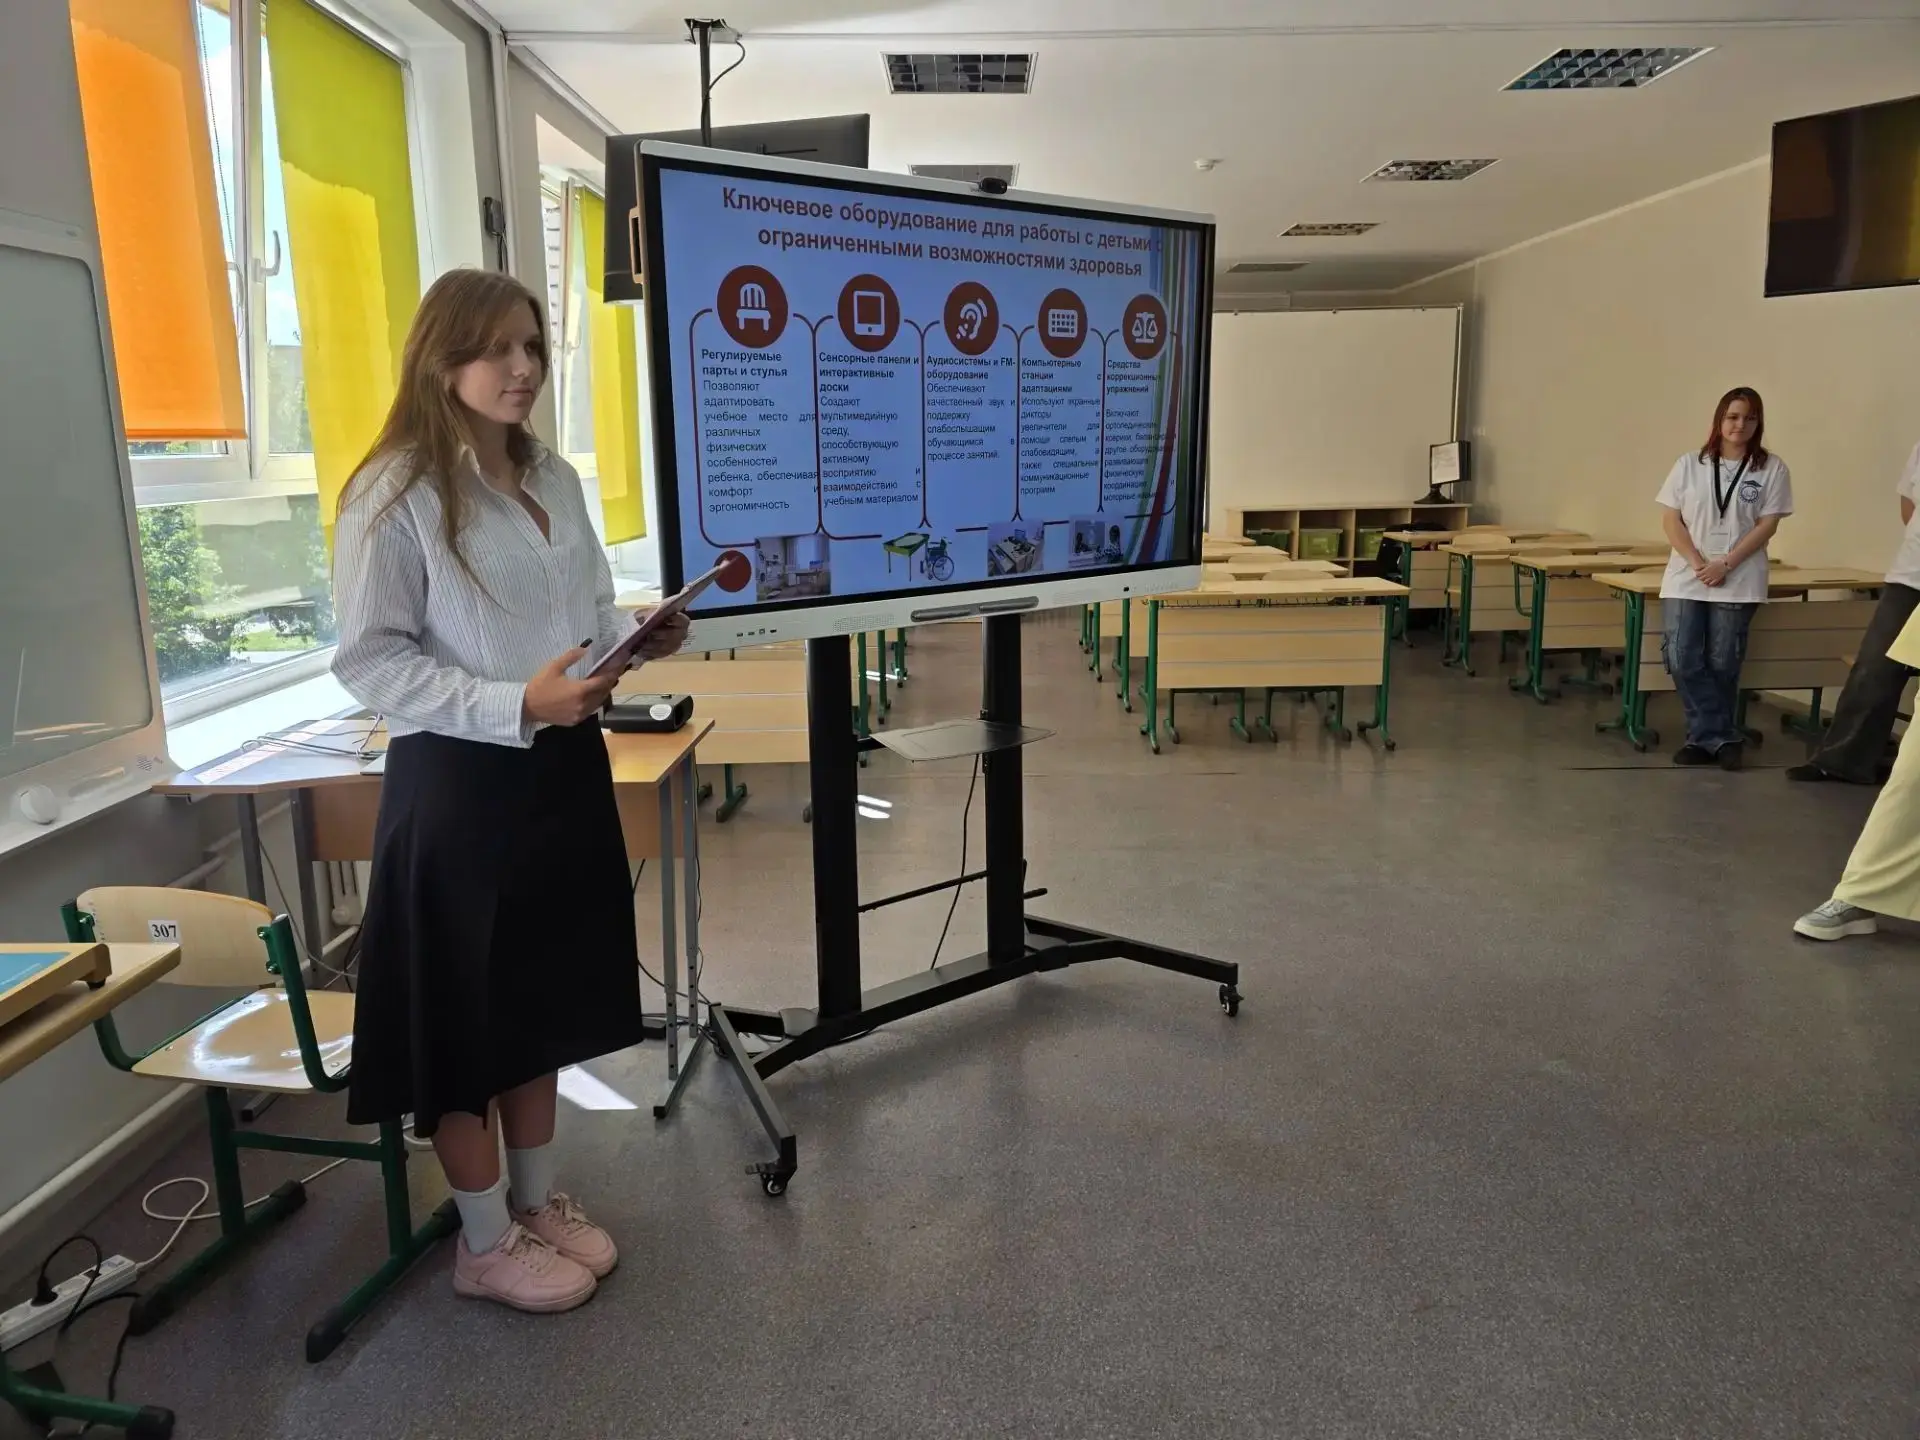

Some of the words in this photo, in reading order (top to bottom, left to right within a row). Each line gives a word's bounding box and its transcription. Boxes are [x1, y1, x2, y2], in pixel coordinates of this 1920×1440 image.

[723, 187, 833, 219] Ключевое
[839, 203, 978, 233] оборудование
[982, 220, 1015, 238] для
[1020, 226, 1080, 245] работы
[1085, 232, 1093, 246] с
[1097, 233, 1151, 251] детьми
[758, 228, 923, 259] ограниченными
[929, 245, 1065, 270] возможностями
[1069, 259, 1142, 277] здоровья
[701, 349, 782, 363] Регулируемые
[819, 352, 875, 365] Сенсорные
[878, 355, 911, 365] панели
[914, 357, 919, 365] и
[926, 355, 991, 367] Аудиосистемы
[1000, 357, 1016, 366] FM-
[1021, 358, 1082, 368] Компьютерные
[1107, 359, 1141, 370] Средства
[702, 366, 737, 377] парты
[740, 367, 747, 376] и
[750, 367, 788, 378] стулья
[819, 368, 894, 379] интерактивные
[926, 369, 989, 381] оборудование
[1021, 372, 1054, 382] станции
[703, 380, 760, 391] Позволяют
[820, 384, 849, 393] доски
[926, 382, 986, 393] Обеспечивают
[1021, 385, 1073, 394] адаптациями
[704, 397, 775, 408] адаптировать
[820, 395, 861, 407] Создают
[927, 397, 983, 407] качественный
[989, 399, 1005, 408] звук
[704, 411, 747, 424] учебное
[758, 413, 788, 422] место
[799, 412, 817, 423] для
[821, 411, 898, 422] мультимедийную
[926, 411, 970, 421] поддержку
[706, 428, 761, 439] различных
[821, 427, 850, 436] среду,
[927, 423, 996, 434] слабослышащим
[706, 442, 767, 453] физических
[821, 439, 899, 450] способствующую
[927, 437, 984, 448] обучающимся
[707, 456, 778, 468] особенностей
[822, 454, 870, 464] активному
[927, 451, 965, 462] процессе
[708, 472, 753, 484] ребенка,
[757, 470, 818, 481] обеспечивая
[823, 468, 877, 478] восприятию
[916, 467, 921, 475] и
[708, 486, 753, 497] комфорт
[823, 480, 898, 492] взаимодействию
[916, 480, 921, 488] с
[824, 496, 864, 507] учебным
[866, 493, 919, 504] материалом
[709, 500, 790, 513] эргономичность
[152, 924, 176, 938] 307
